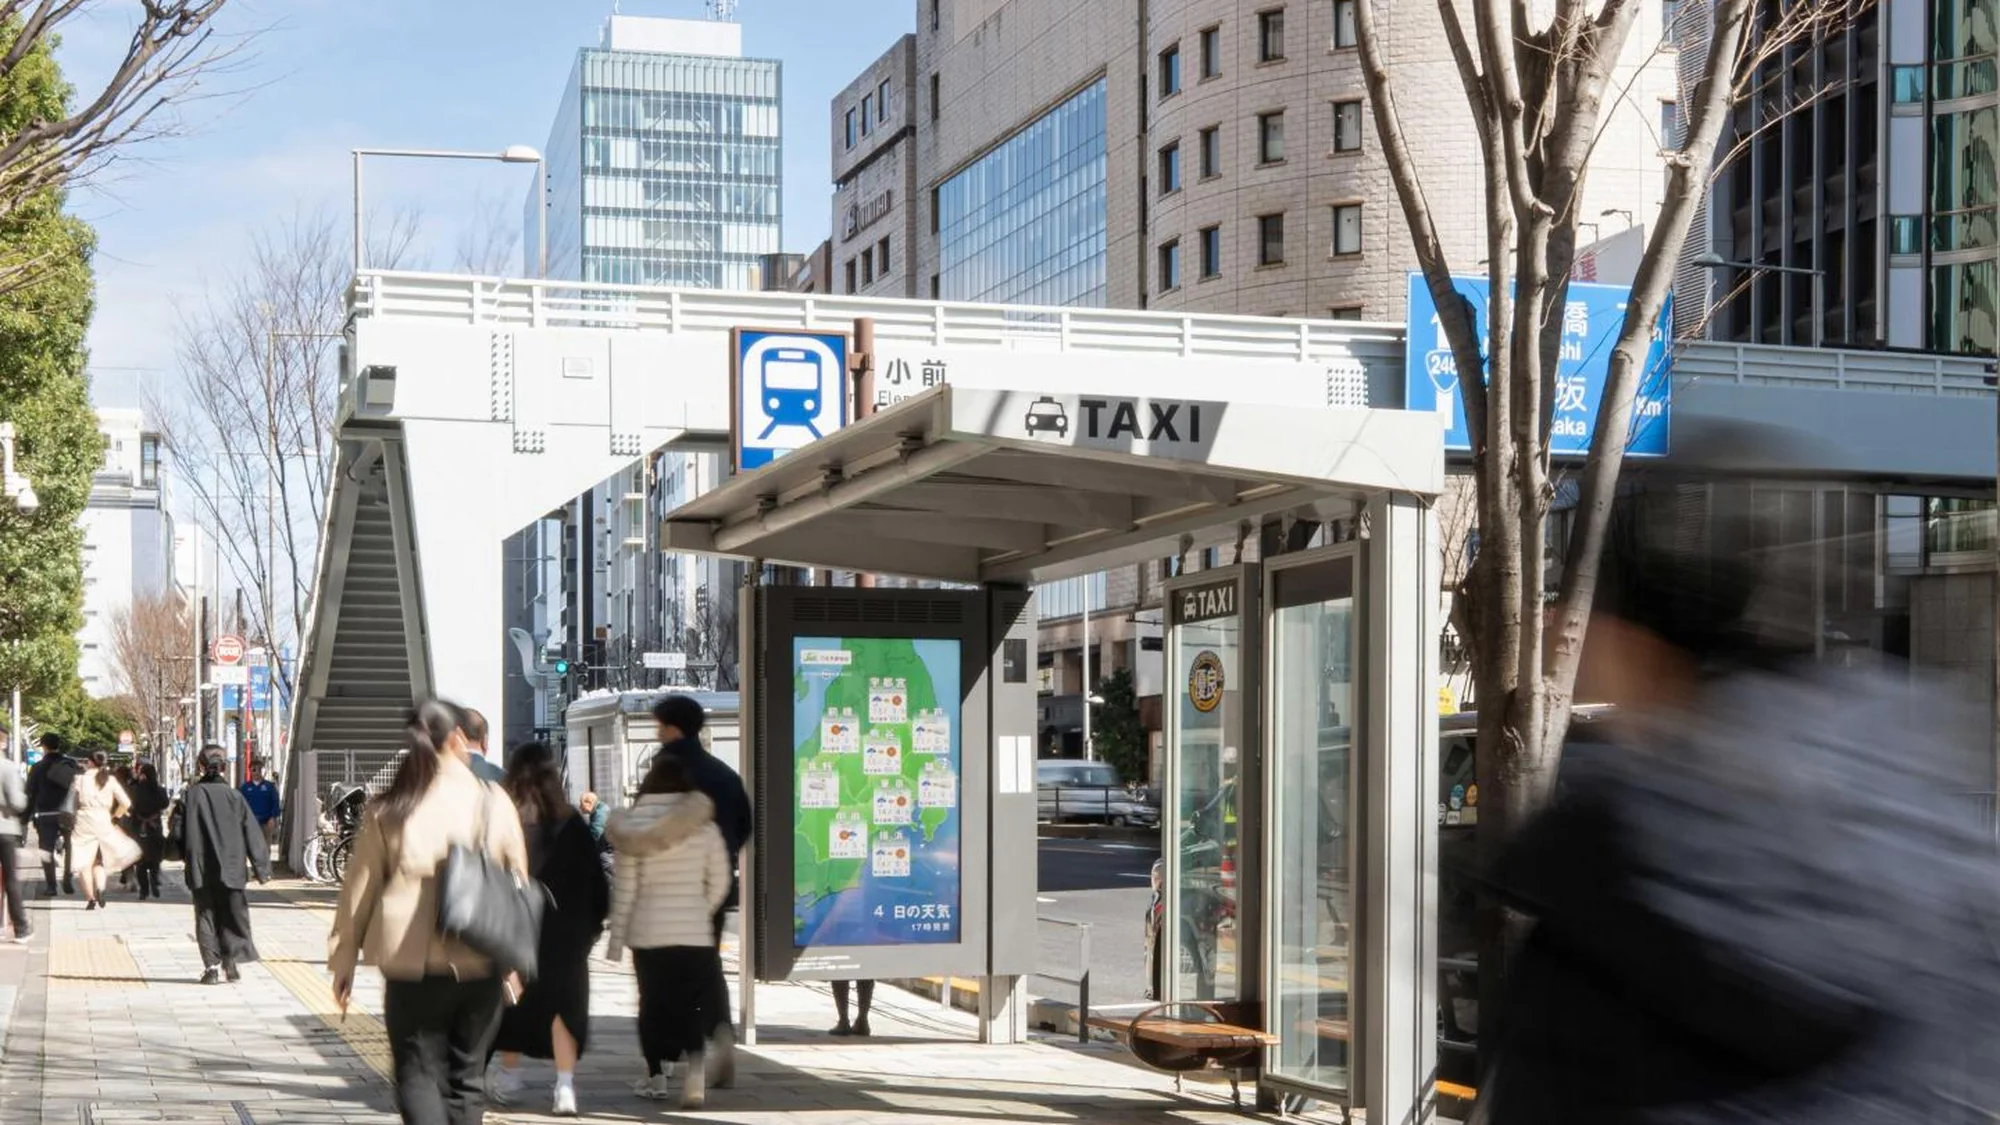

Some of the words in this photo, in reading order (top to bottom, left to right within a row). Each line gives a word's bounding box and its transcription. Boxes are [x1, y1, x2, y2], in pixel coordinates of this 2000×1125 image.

[1079, 399, 1201, 444] TAXI
[1552, 420, 1587, 436] aka
[1198, 586, 1233, 617] TAXI
[874, 904, 884, 917] 4
[894, 904, 951, 919] 日の天気
